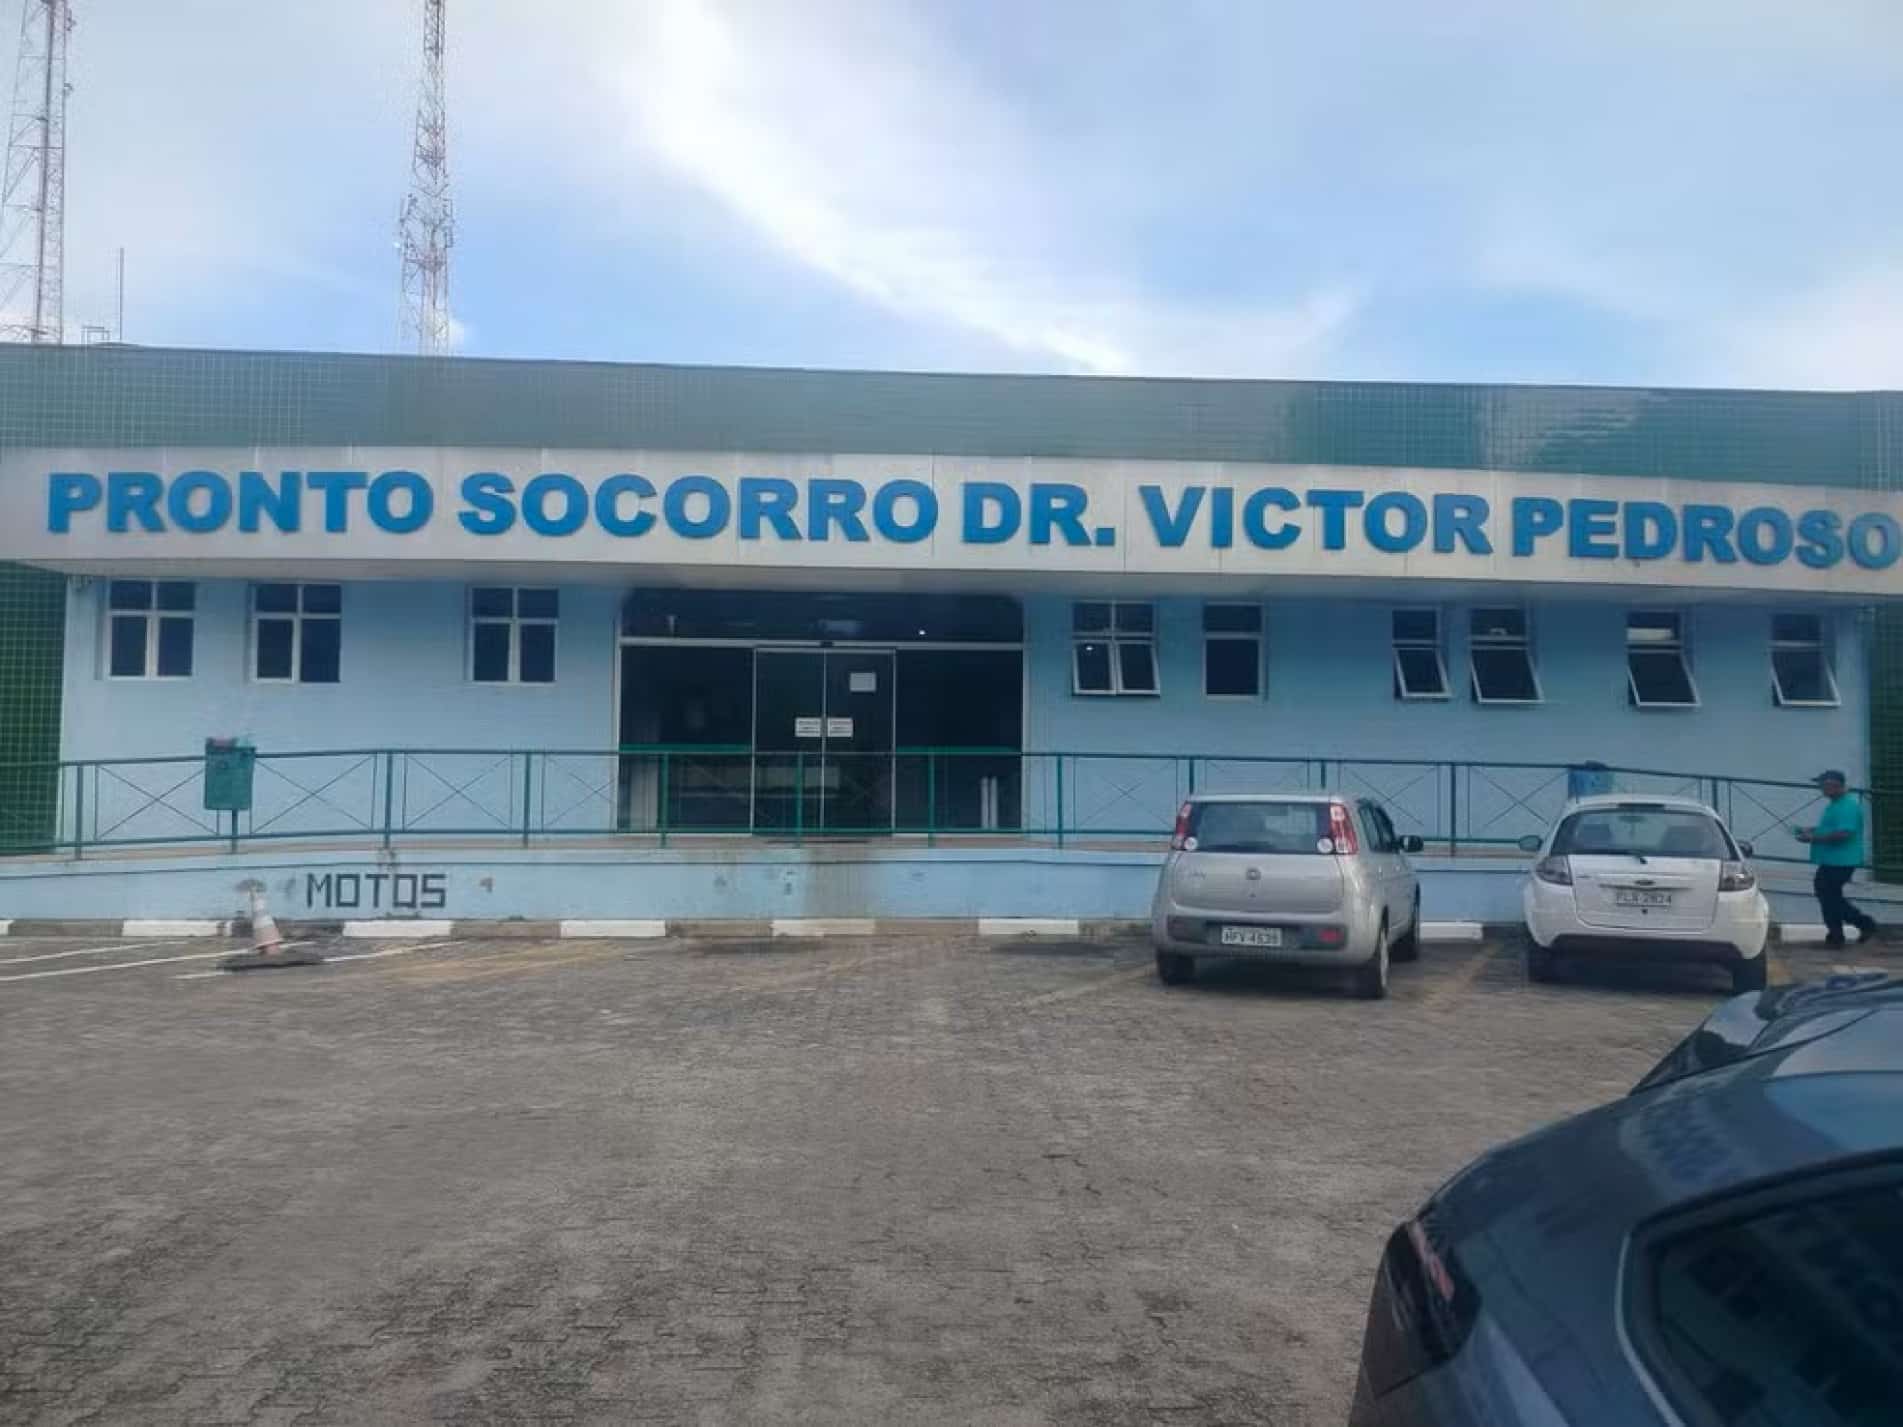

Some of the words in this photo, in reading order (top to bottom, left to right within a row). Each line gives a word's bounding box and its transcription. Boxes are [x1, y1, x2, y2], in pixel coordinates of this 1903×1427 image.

[47, 471, 435, 535] PRONTO
[458, 473, 939, 543] SOCORRO
[961, 481, 1116, 547] DR.
[1138, 485, 1493, 555] VICTOR
[1511, 497, 1903, 571] PEDROSO
[307, 873, 447, 908] MOTOS
